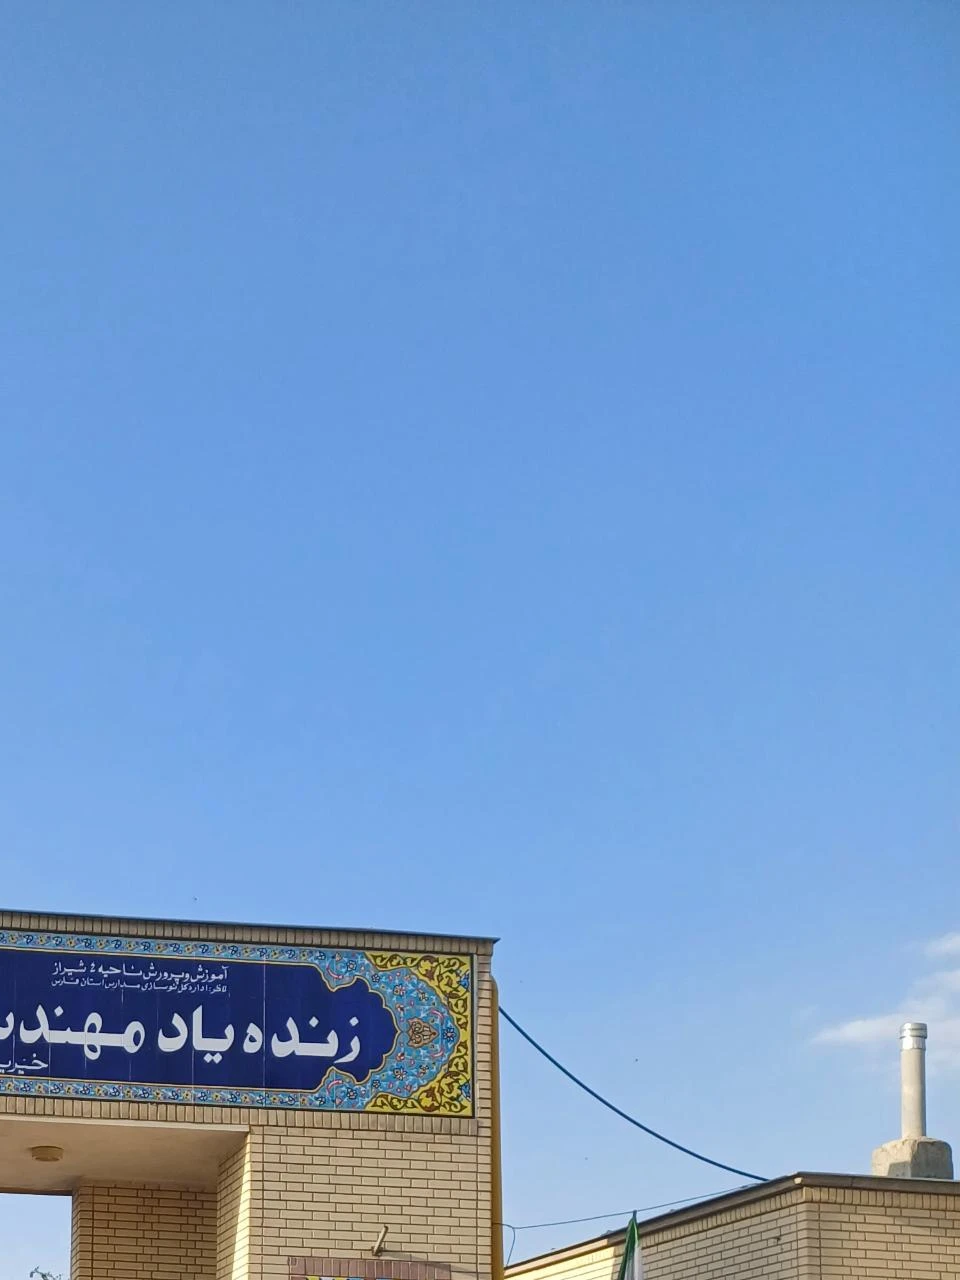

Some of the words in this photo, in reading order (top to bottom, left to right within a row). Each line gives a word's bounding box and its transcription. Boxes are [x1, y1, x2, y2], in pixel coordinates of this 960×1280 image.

[52, 959, 87, 976] شیراز
[142, 962, 186, 985] پرورش
[190, 964, 229, 982] آموزش
[51, 976, 79, 987] فارس
[80, 977, 104, 987] استان
[158, 1005, 234, 1064] یاد
[243, 1016, 361, 1063] زنده
